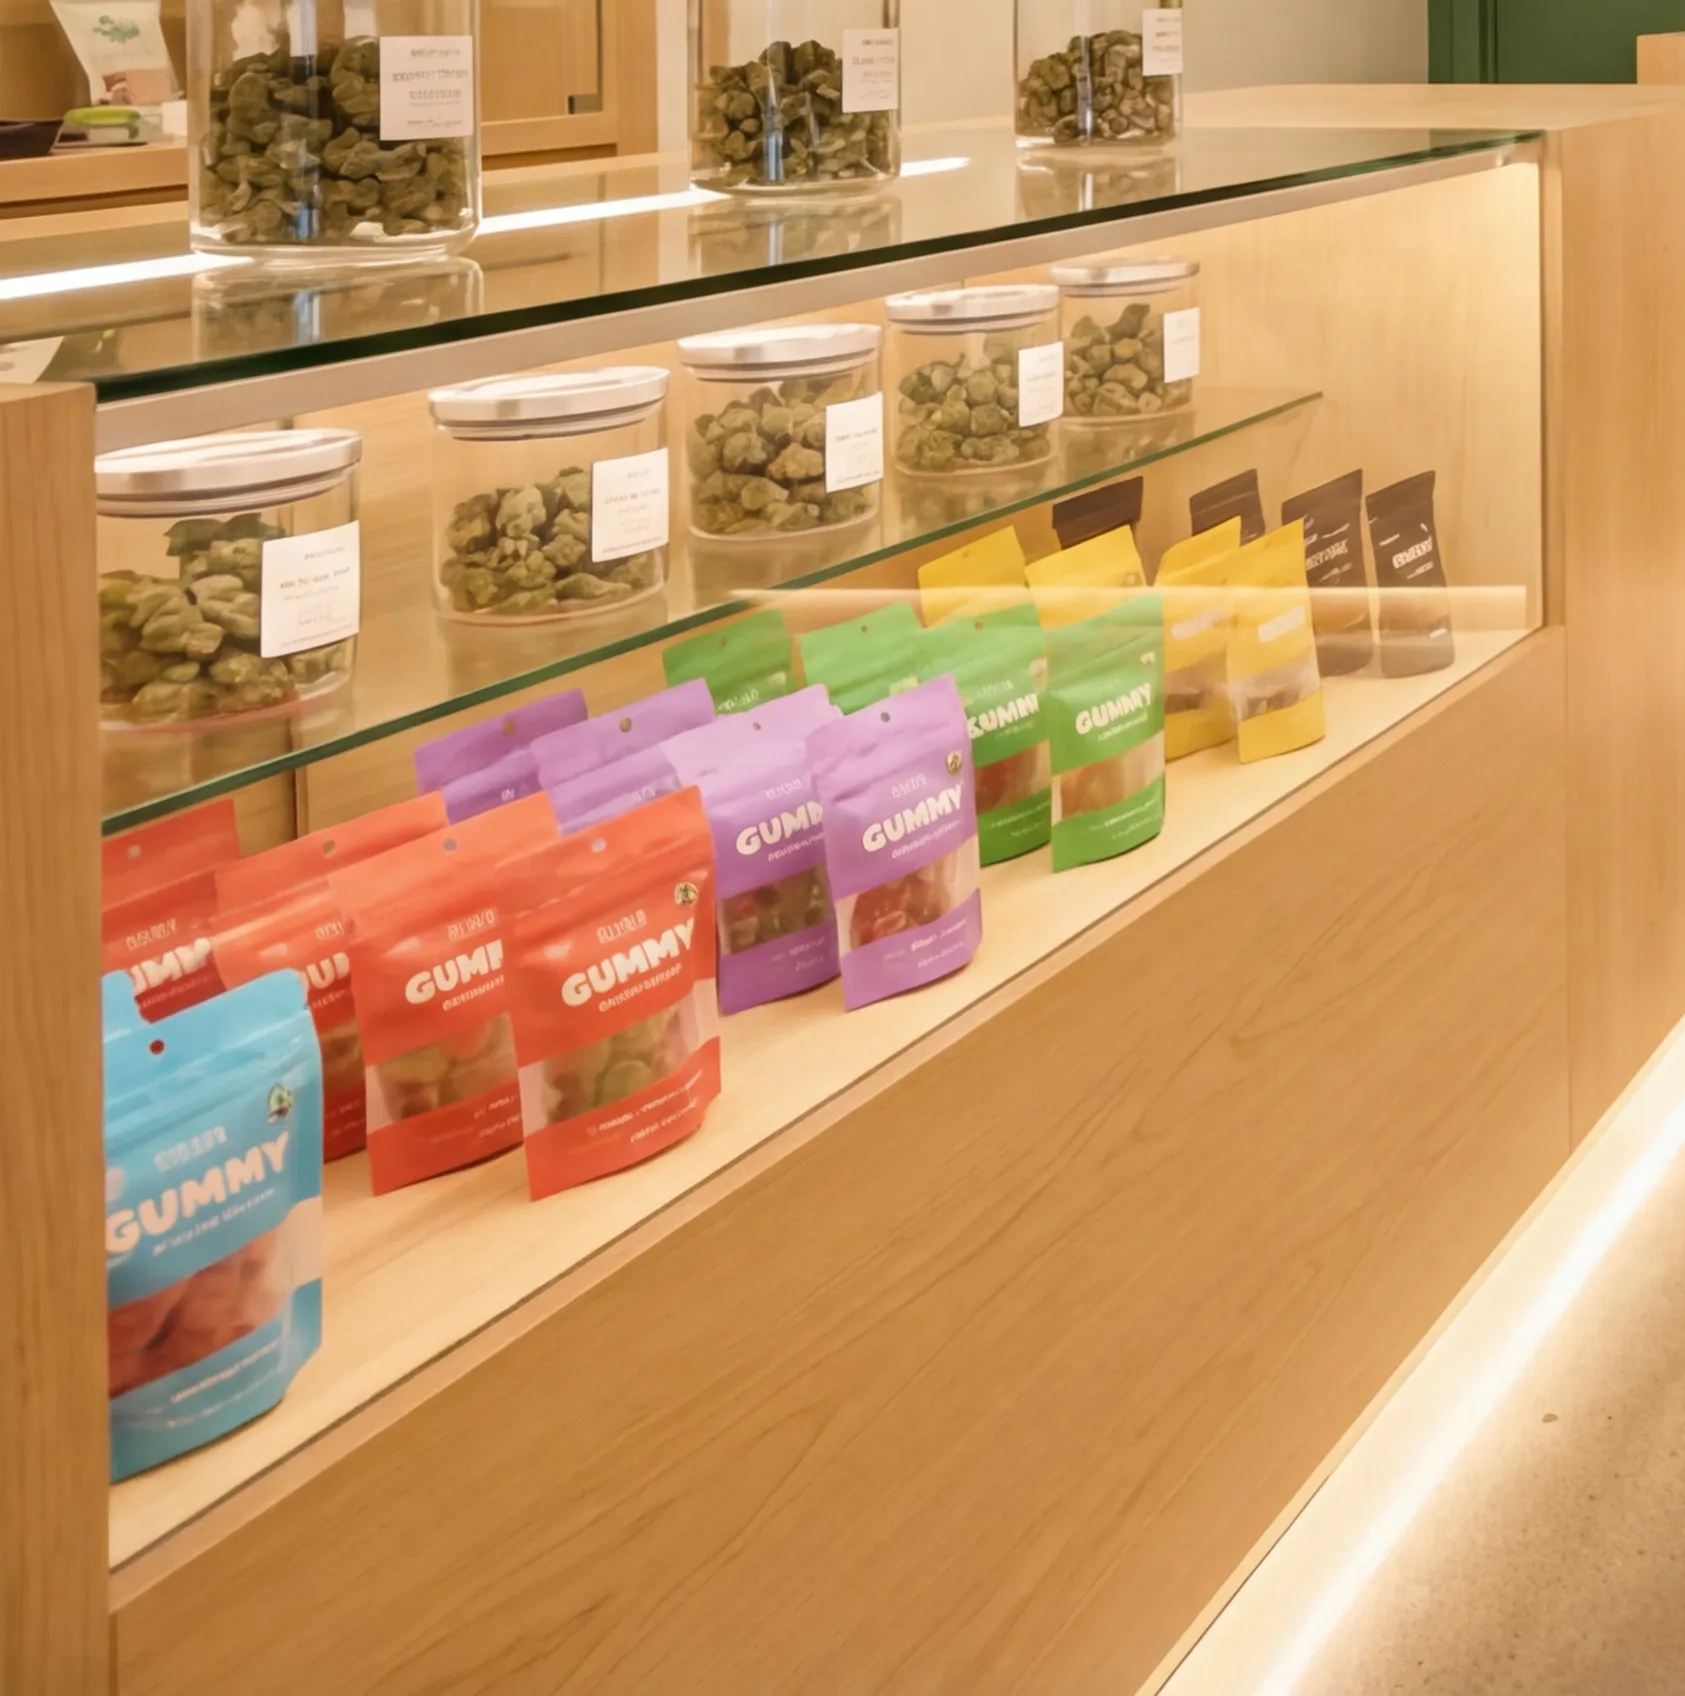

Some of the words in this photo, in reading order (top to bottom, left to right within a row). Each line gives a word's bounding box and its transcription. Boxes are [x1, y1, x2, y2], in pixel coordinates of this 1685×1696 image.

[1075, 682, 1151, 734] GUMMY
[862, 784, 962, 852] GUMMY
[561, 916, 694, 1006] GUMMY
[105, 1130, 289, 1253] GUMMY
